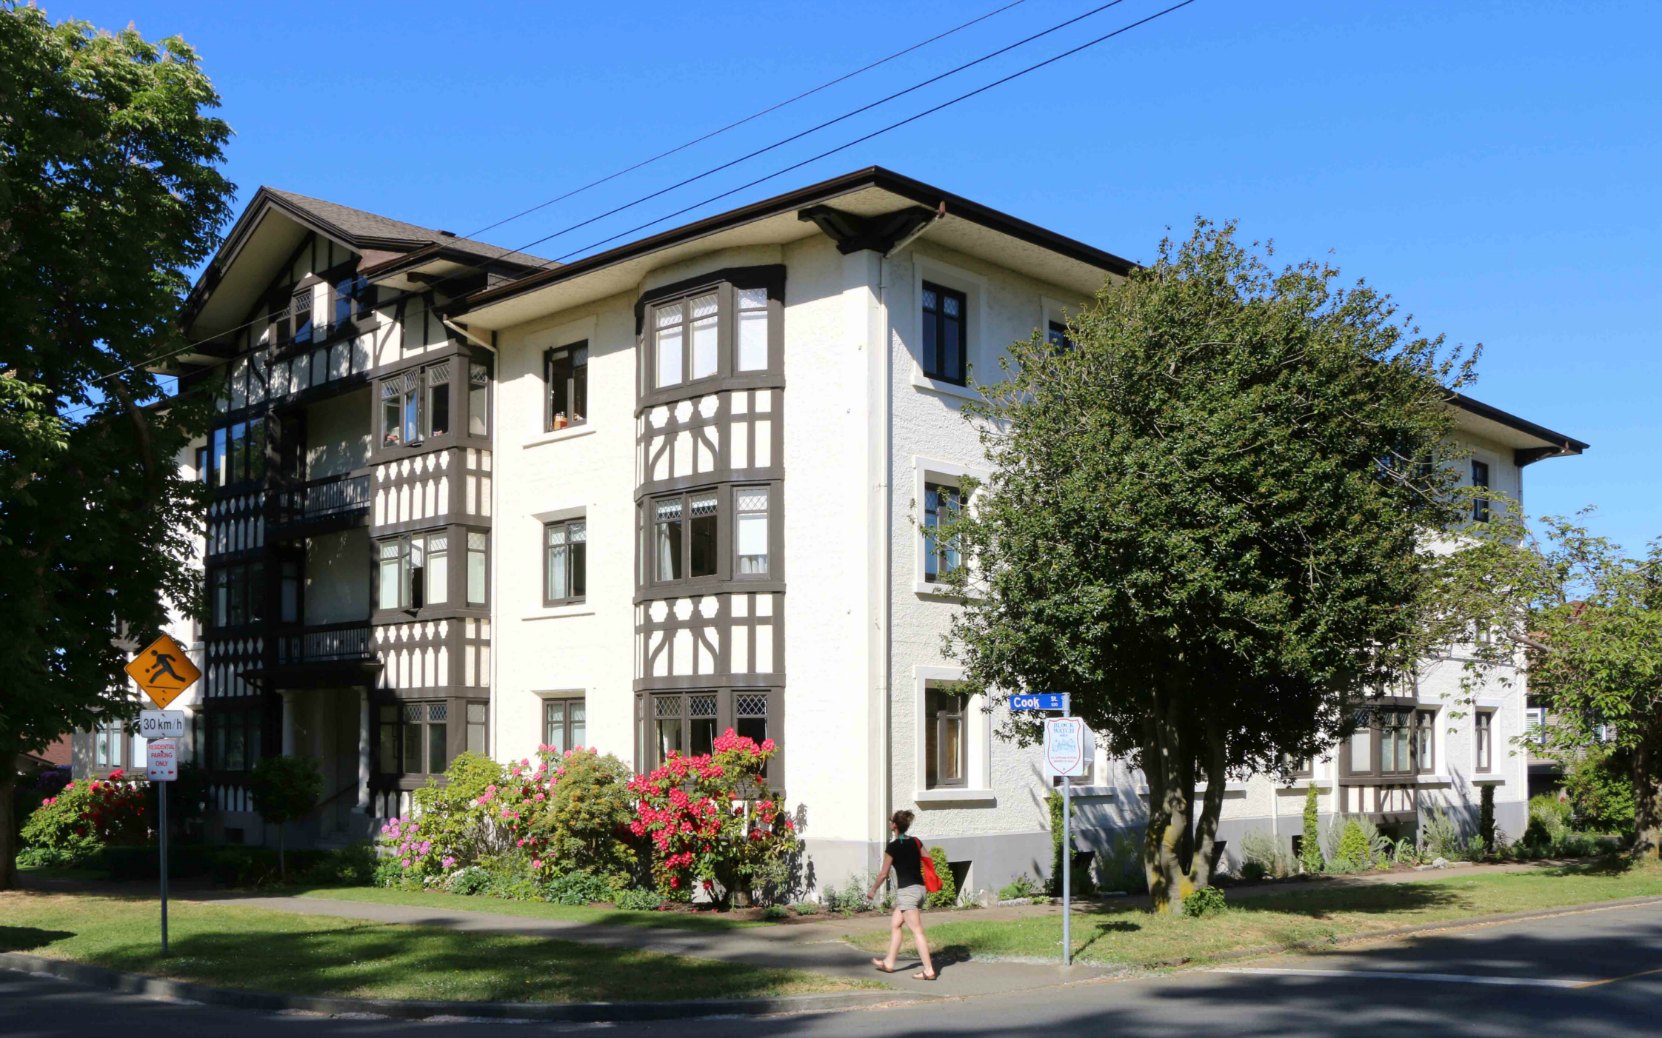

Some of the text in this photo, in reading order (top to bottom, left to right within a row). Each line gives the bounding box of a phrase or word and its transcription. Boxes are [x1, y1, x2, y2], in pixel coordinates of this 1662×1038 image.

[1014, 697, 1040, 708] Cook
[144, 718, 182, 730] 30 km/h
